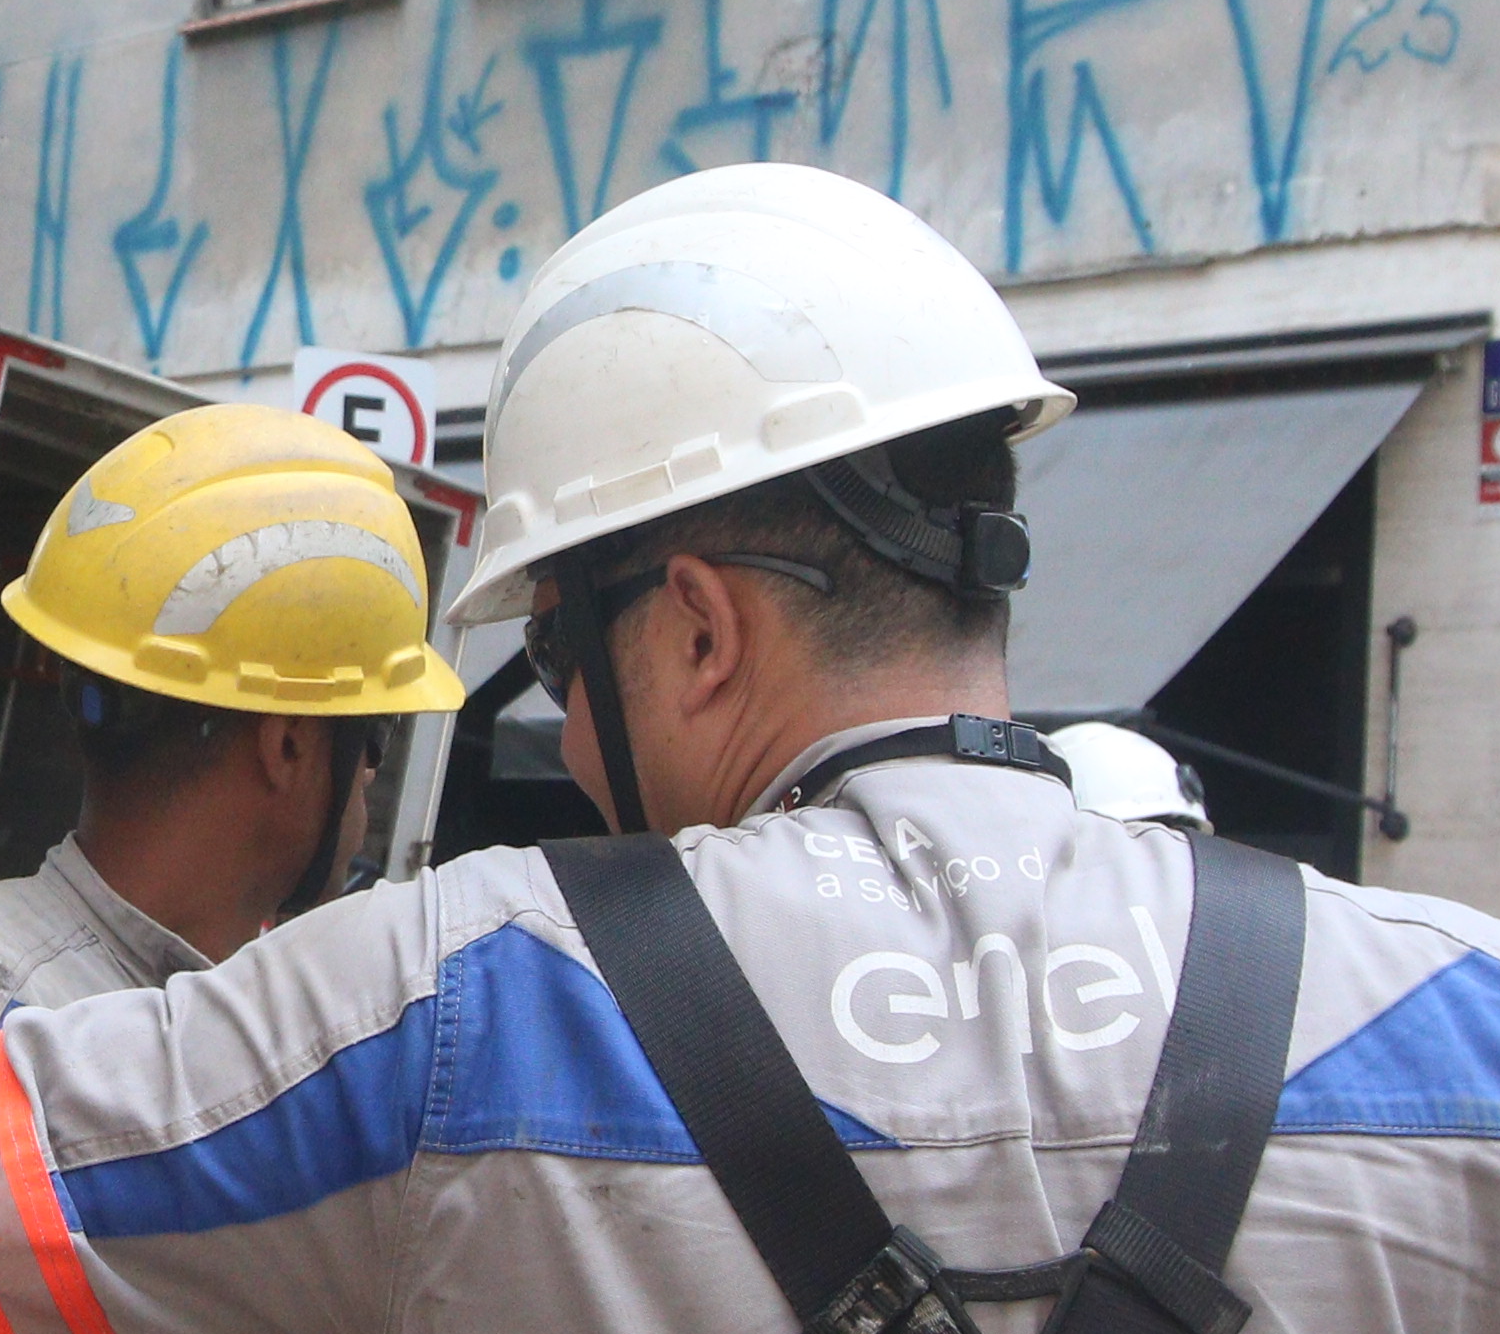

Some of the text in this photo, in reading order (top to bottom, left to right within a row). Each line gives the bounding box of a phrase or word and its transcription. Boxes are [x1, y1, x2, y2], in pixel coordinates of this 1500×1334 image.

[816, 846, 1049, 913] a serviço d
[831, 904, 1178, 1064] enel
